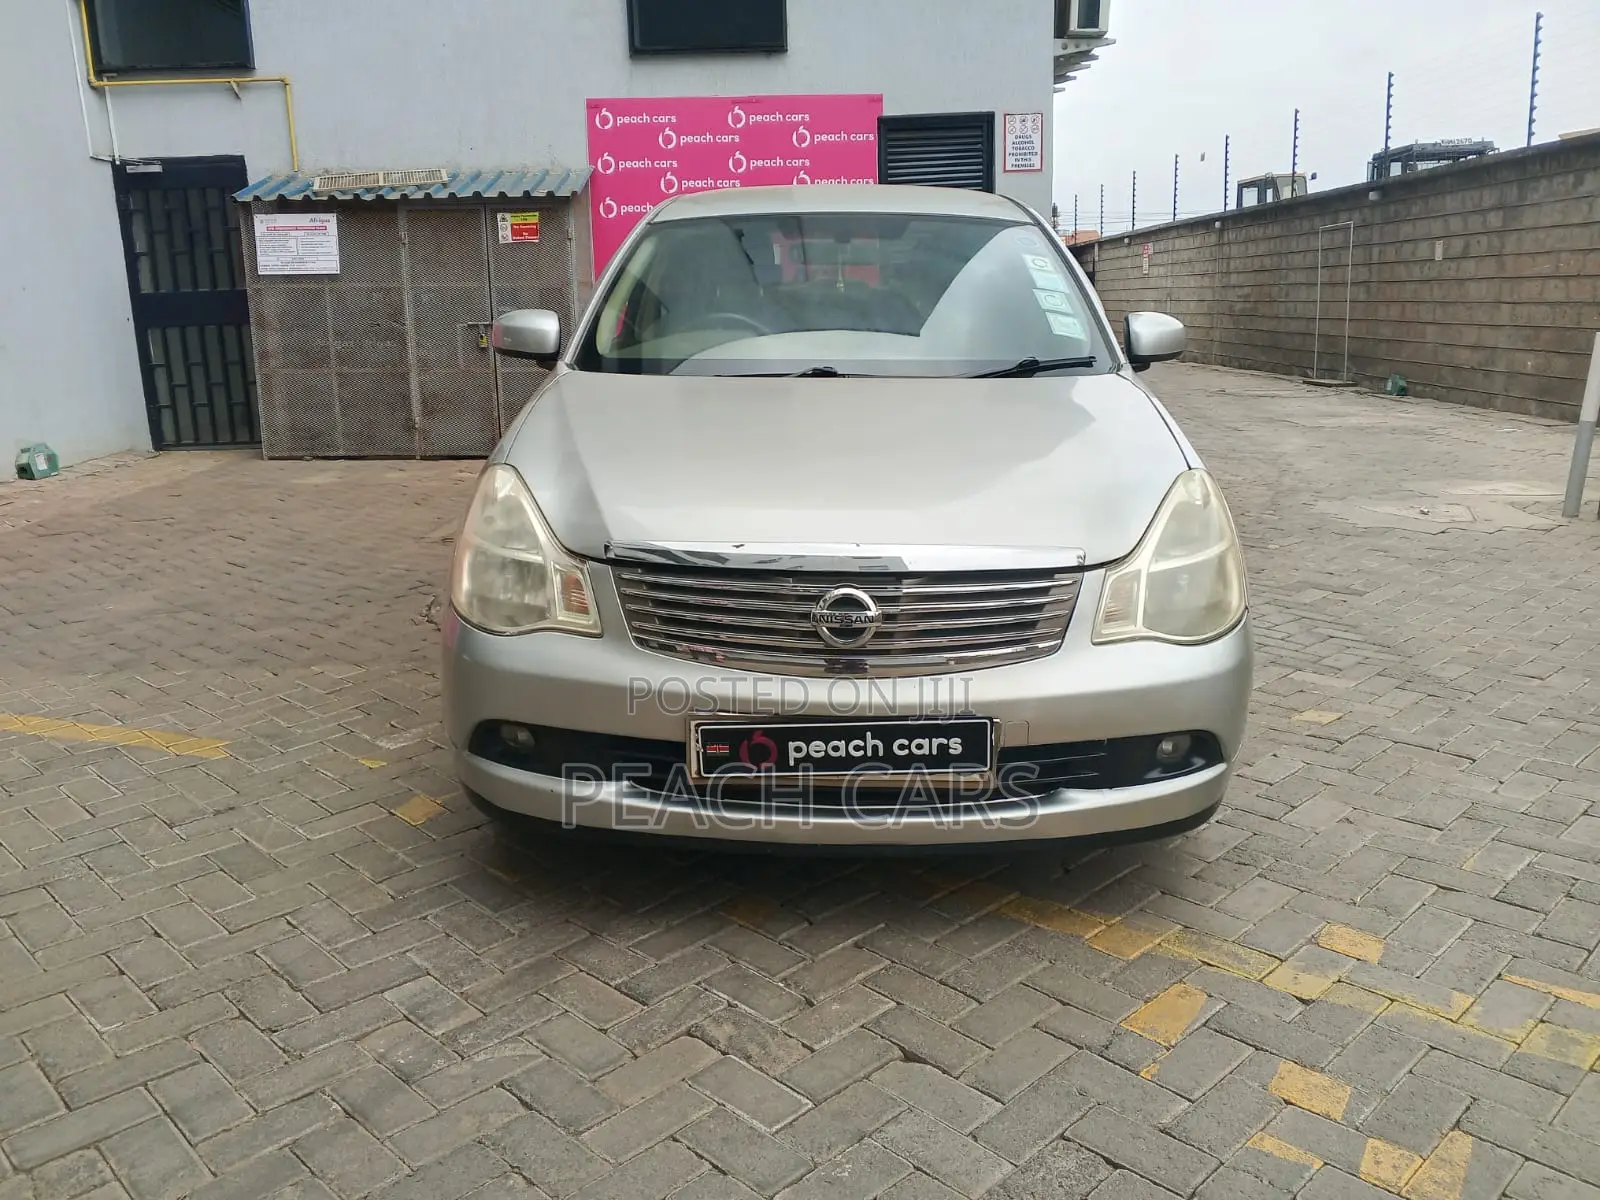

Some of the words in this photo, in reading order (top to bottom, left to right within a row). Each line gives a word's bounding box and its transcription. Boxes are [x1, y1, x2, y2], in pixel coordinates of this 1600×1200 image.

[617, 112, 651, 126] peach
[653, 115, 677, 123] cars
[750, 111, 783, 125] peach
[785, 113, 810, 122] cars
[680, 131, 714, 145] peach
[715, 134, 740, 143] cars
[814, 130, 848, 144] peach
[850, 133, 875, 141] cars
[619, 157, 652, 171] peach
[654, 160, 678, 168] cars
[750, 156, 783, 170] peach
[785, 158, 810, 167] cars
[681, 176, 715, 190] peach
[716, 179, 741, 187] cars
[814, 175, 848, 185] peach
[621, 202, 655, 216] peach
[818, 614, 875, 624] NISSAN
[788, 731, 884, 766] peach
[893, 737, 963, 756] cars
